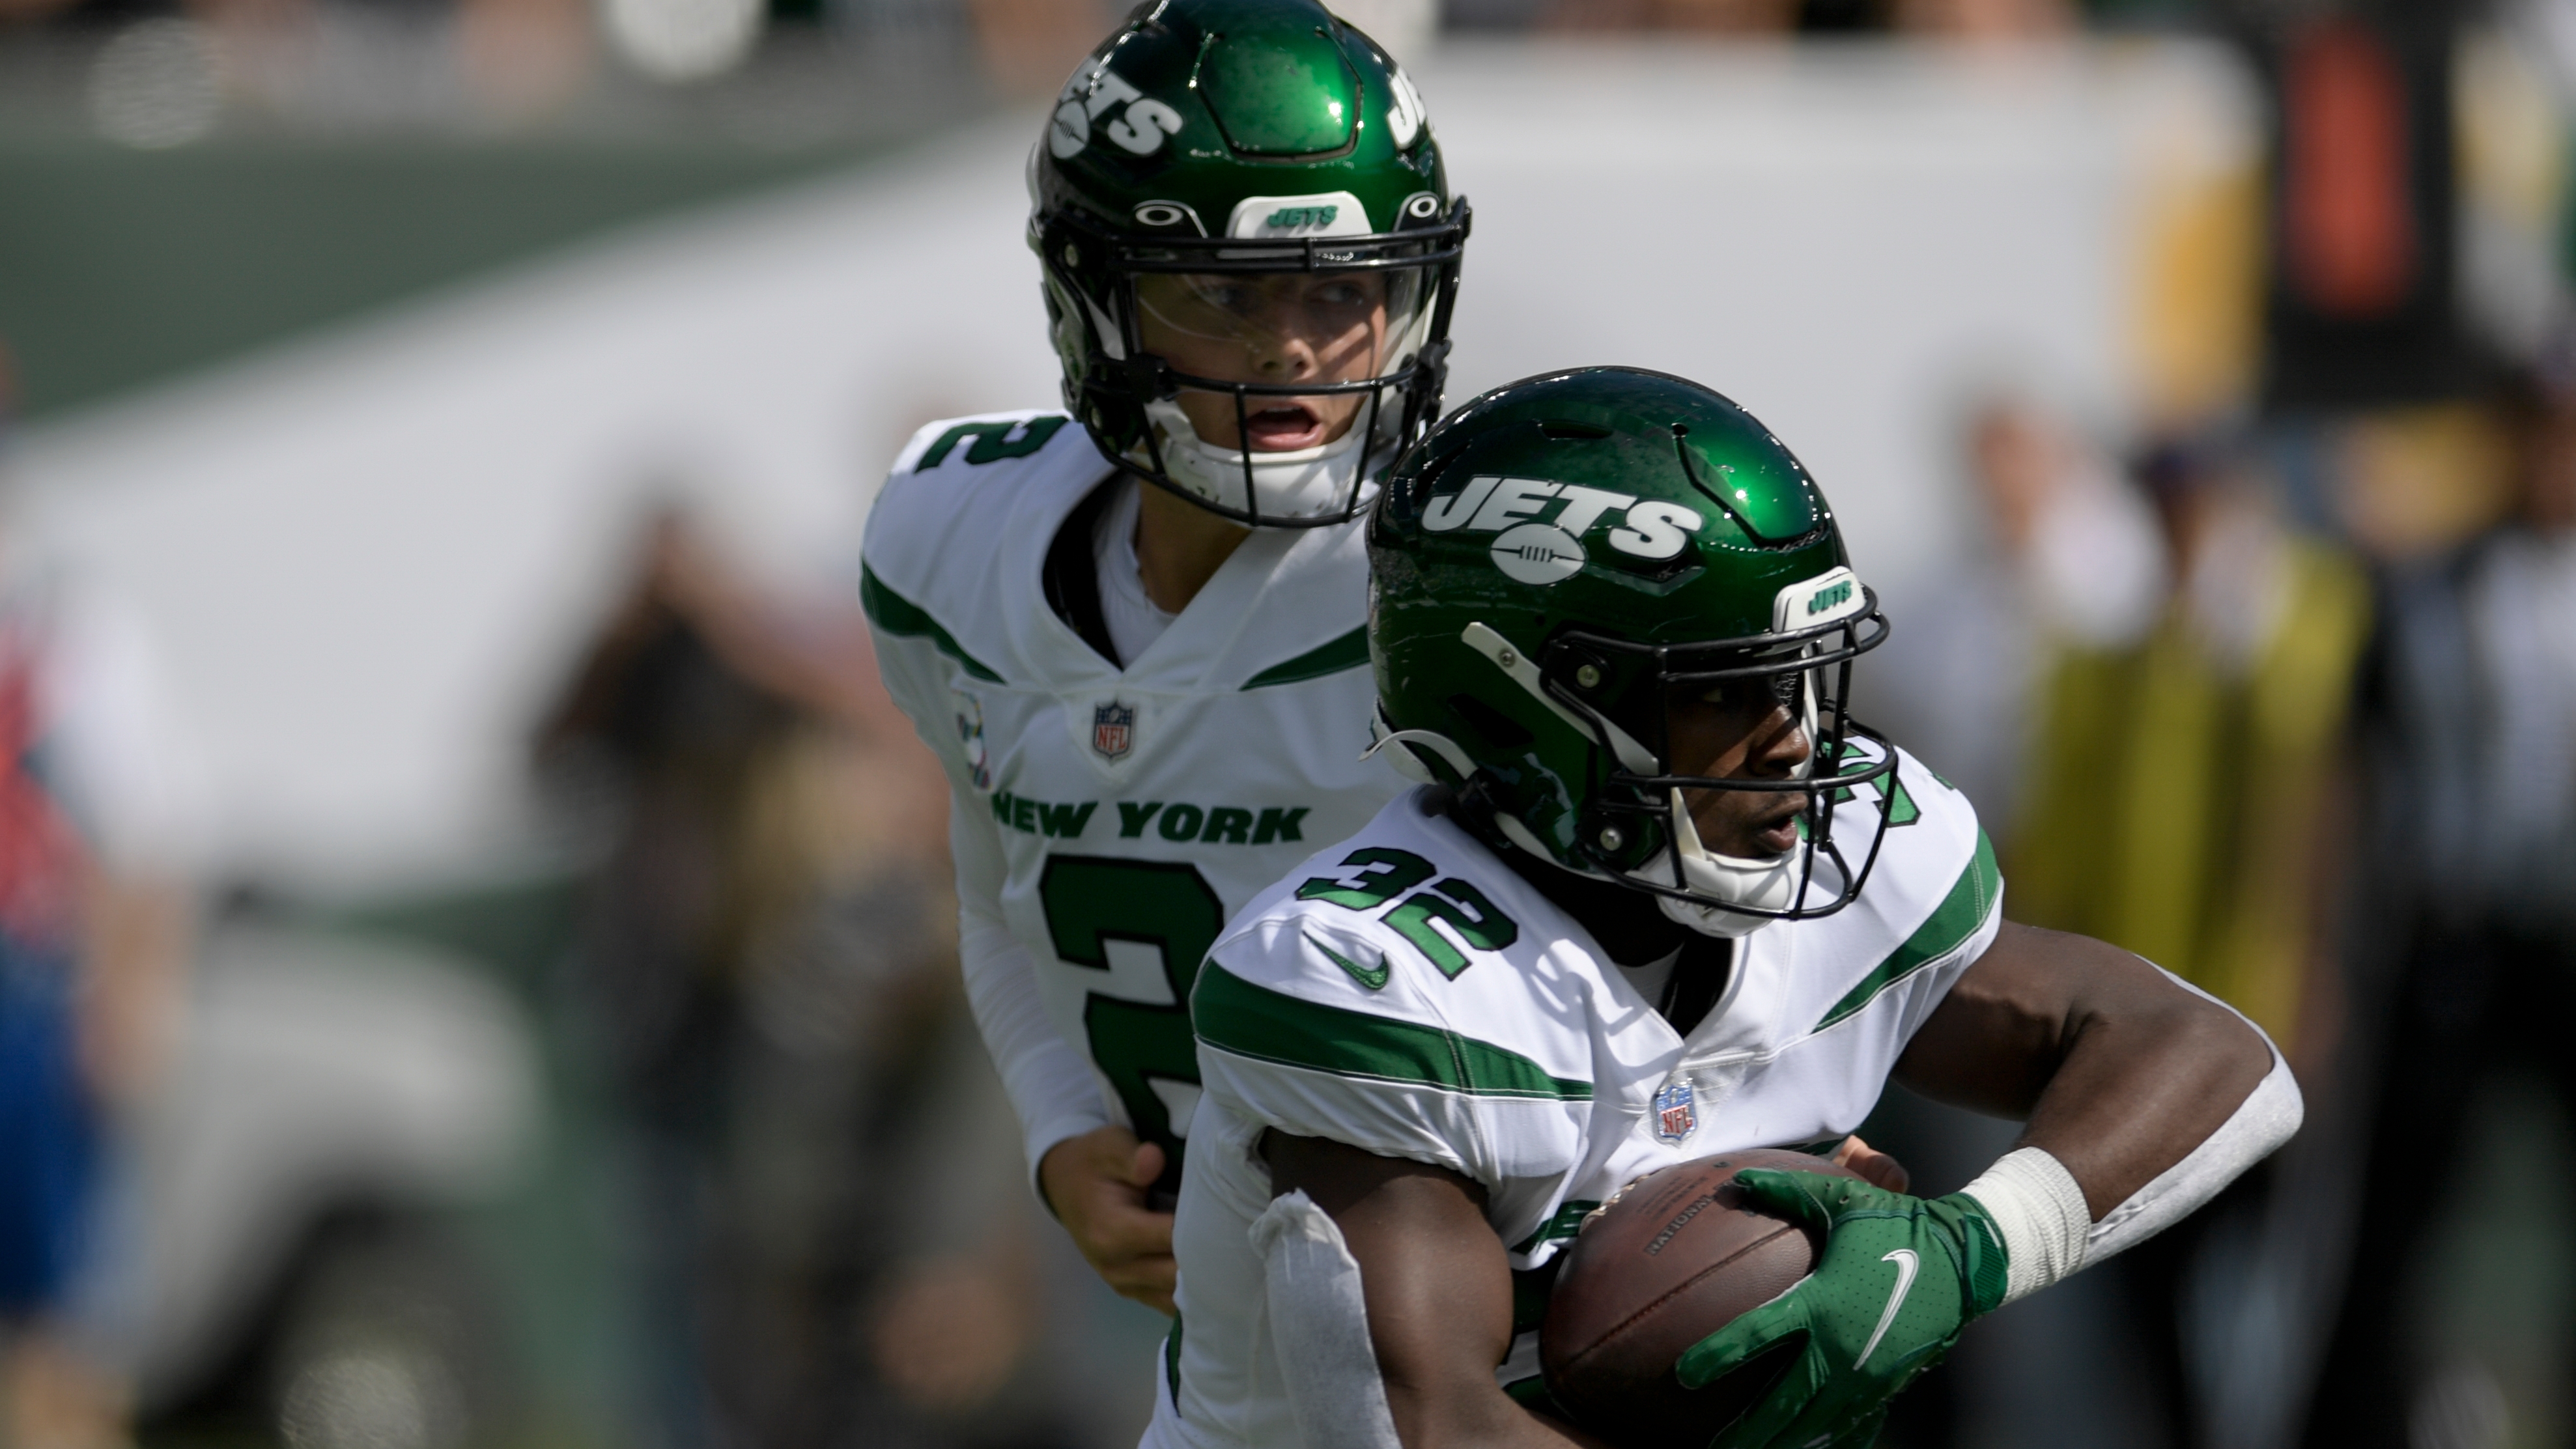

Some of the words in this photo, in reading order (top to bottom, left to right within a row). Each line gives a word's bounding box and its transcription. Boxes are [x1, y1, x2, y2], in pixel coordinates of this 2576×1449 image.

[1266, 205, 1338, 228] JETS
[1421, 474, 1703, 561] JETS
[1808, 580, 1852, 613] JETS
[1097, 724, 1127, 752] NFL
[991, 790, 1099, 839] NEW
[1118, 801, 1312, 845] YORK
[1294, 847, 1518, 982] 32
[1038, 854, 1225, 1205] 2
[1660, 1105, 1693, 1134] NFL
[1645, 1194, 1714, 1256] NATIONAL
